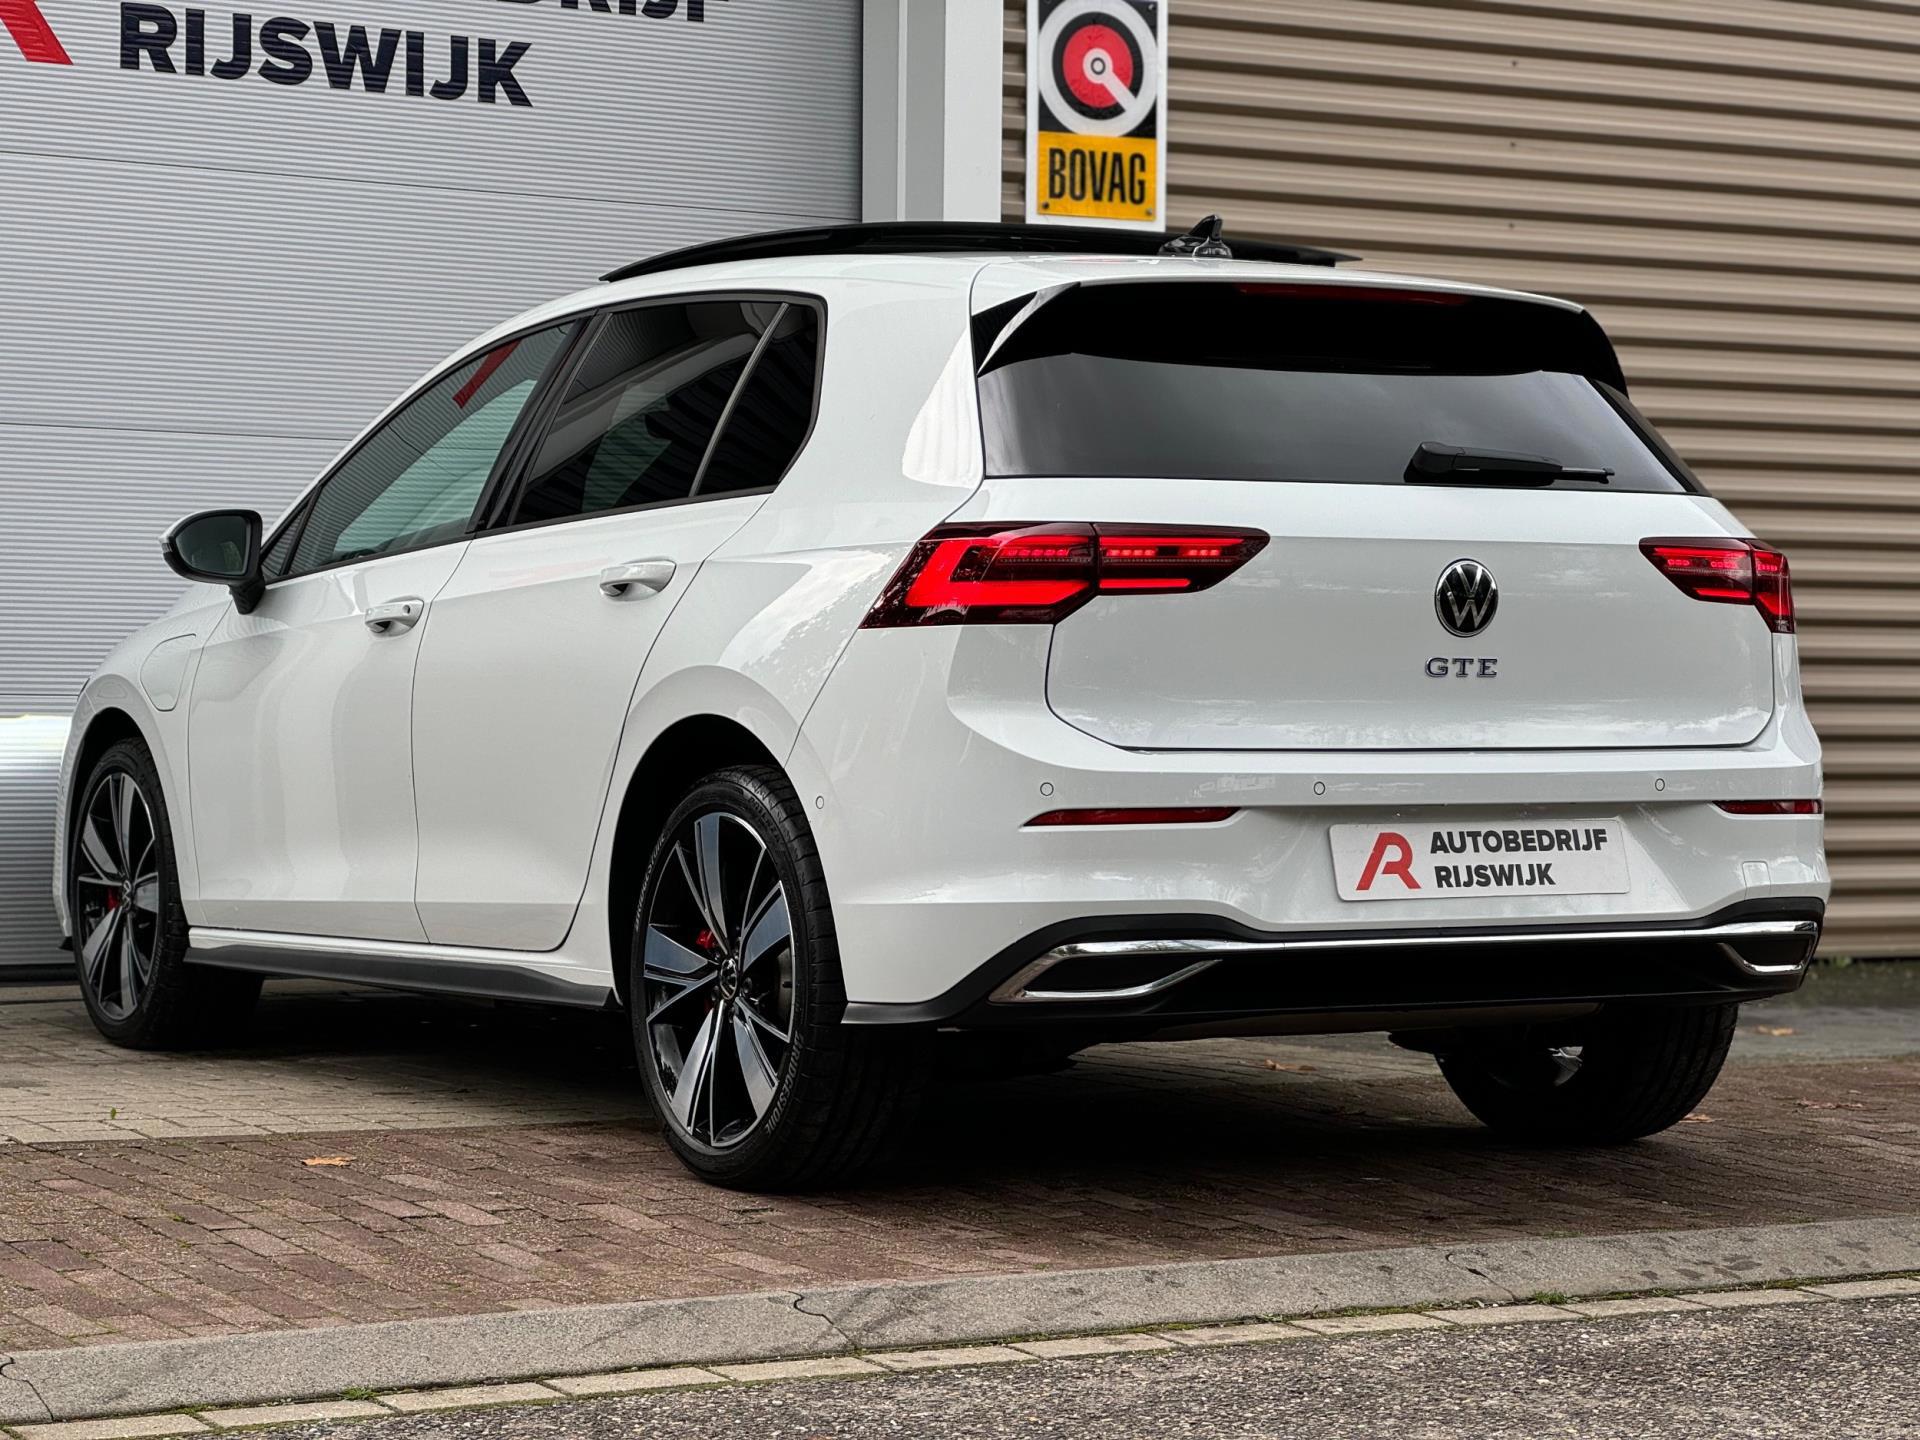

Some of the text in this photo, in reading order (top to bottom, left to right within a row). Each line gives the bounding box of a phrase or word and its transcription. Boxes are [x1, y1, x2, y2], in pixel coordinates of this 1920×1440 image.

[119, 1, 534, 108] RIJSWIJK
[1048, 147, 1147, 205] BOVAG
[1424, 656, 1498, 678] GTE
[1430, 828, 1608, 854] AUTOBEDRIJF
[1434, 863, 1556, 888] RIJSWIJK
